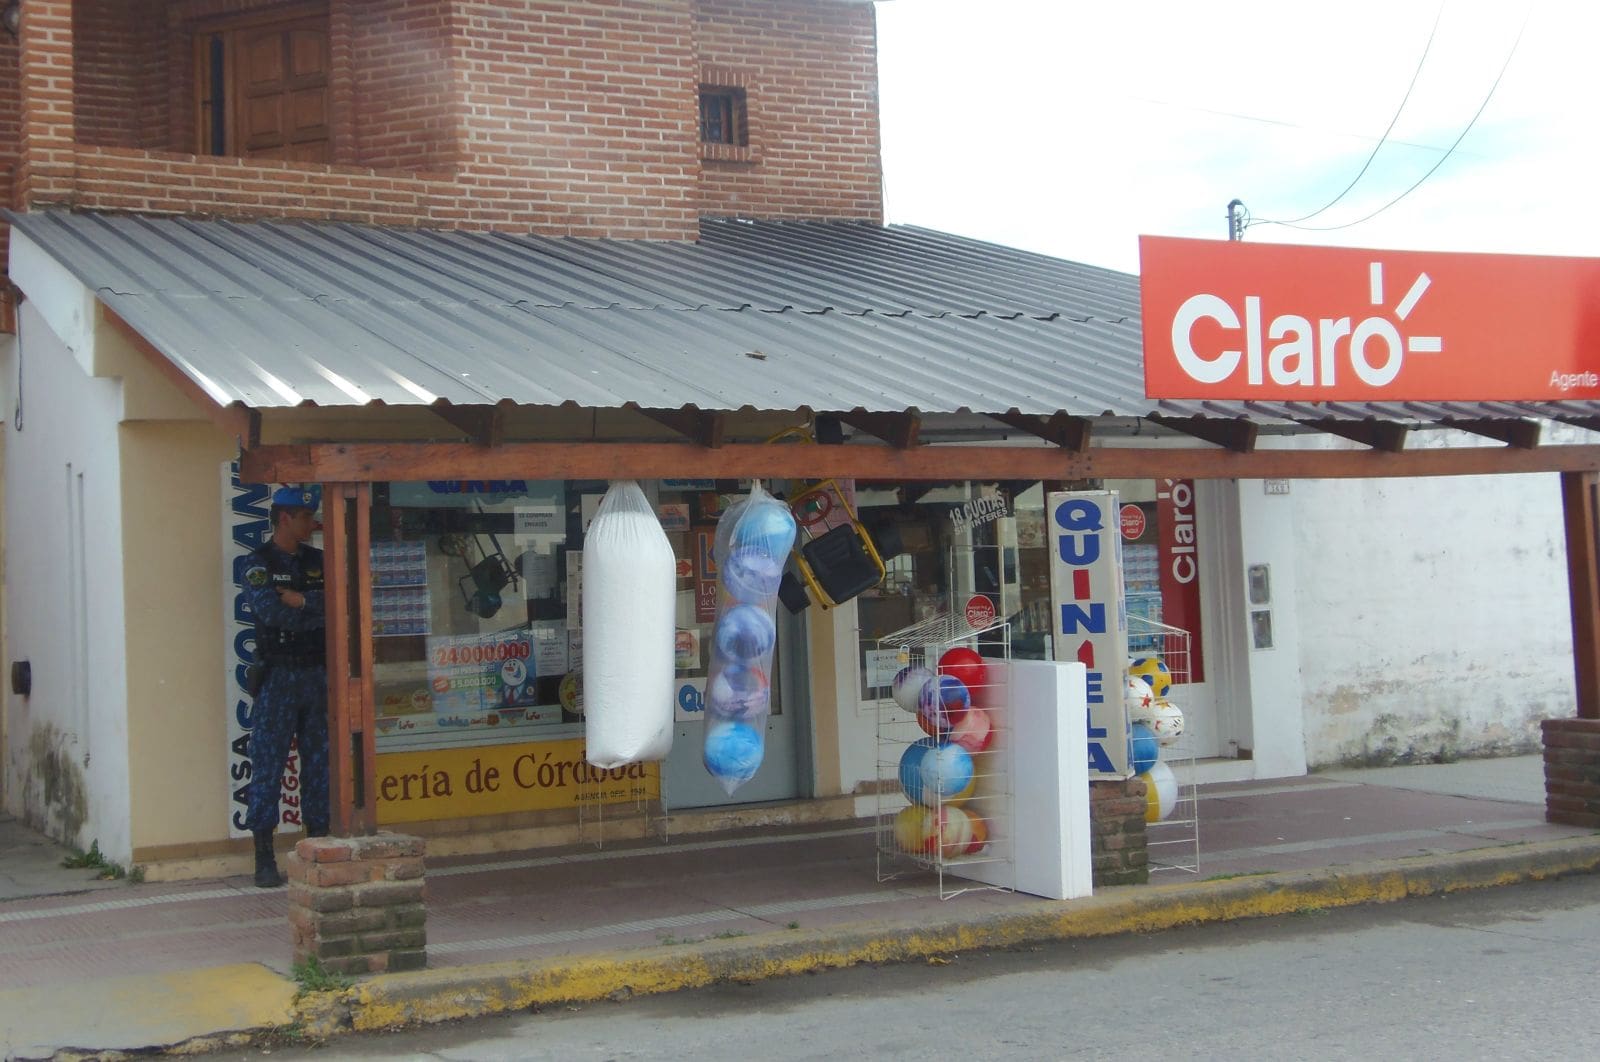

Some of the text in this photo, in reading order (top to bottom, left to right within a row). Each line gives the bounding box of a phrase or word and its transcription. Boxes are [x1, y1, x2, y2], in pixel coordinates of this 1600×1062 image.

[1171, 293, 1403, 387] Claro
[1549, 369, 1598, 391] Agente
[1170, 483, 1197, 583] Claro
[376, 765, 453, 801] ería
[465, 758, 500, 794] de
